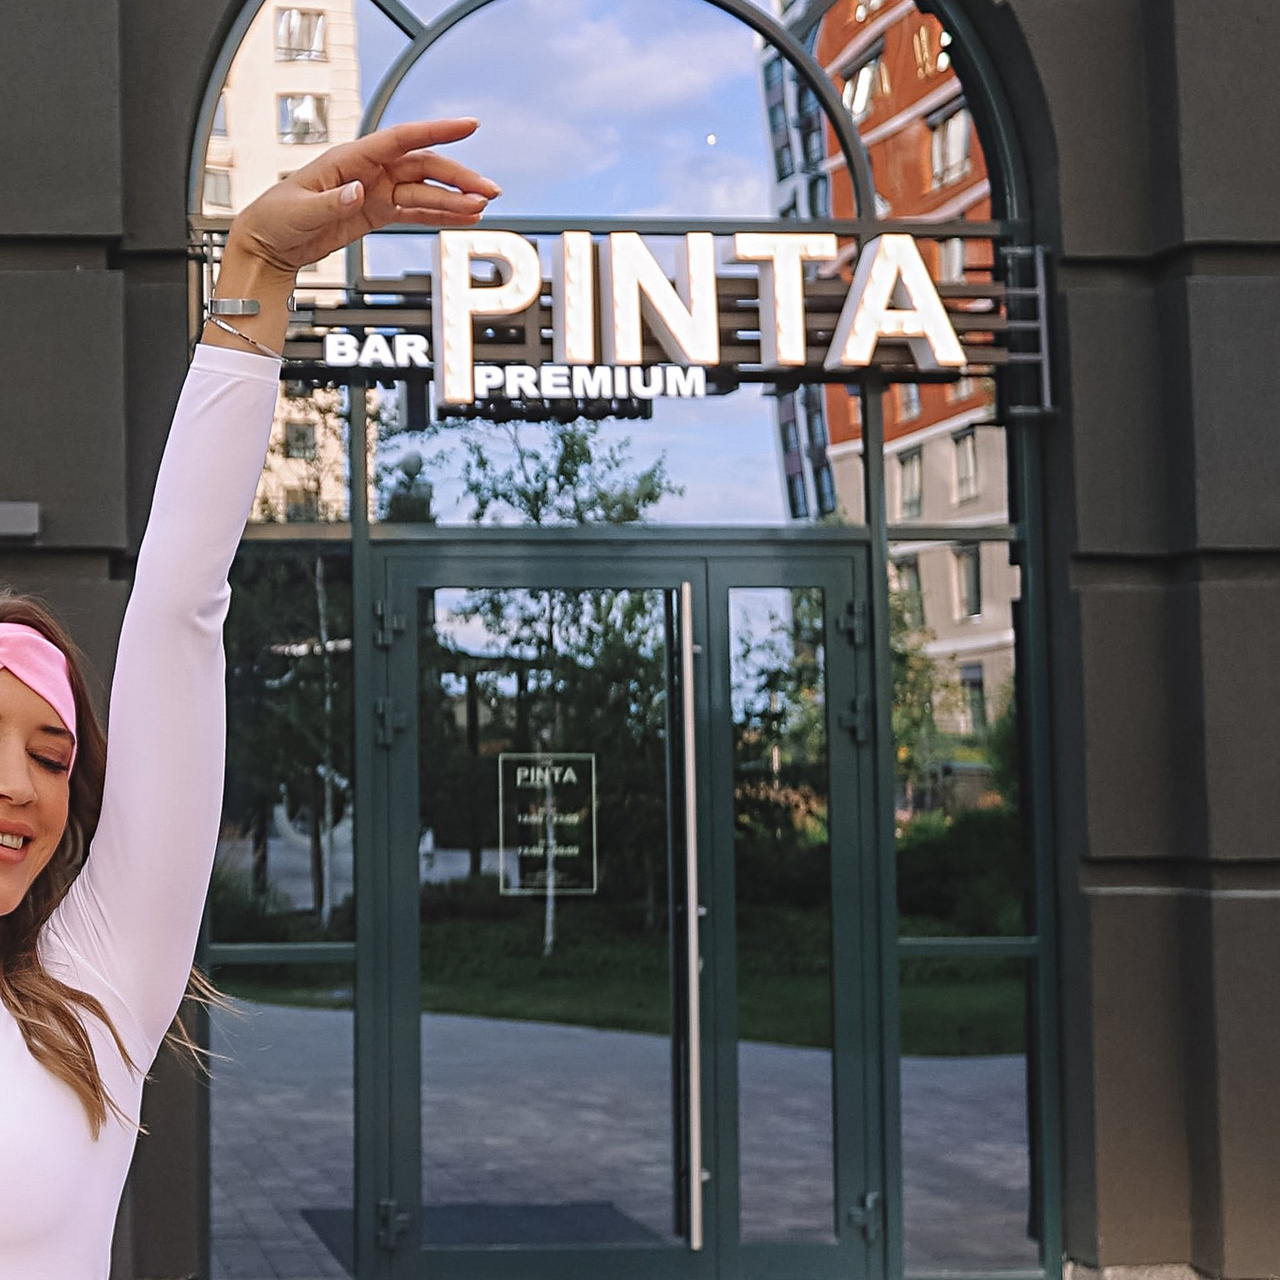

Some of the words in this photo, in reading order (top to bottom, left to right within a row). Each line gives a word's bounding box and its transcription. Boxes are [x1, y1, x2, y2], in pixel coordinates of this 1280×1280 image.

[434, 230, 967, 404] PINTA
[324, 332, 430, 367] BAR
[474, 365, 705, 399] PREMIUM
[516, 766, 577, 786] PINTA
